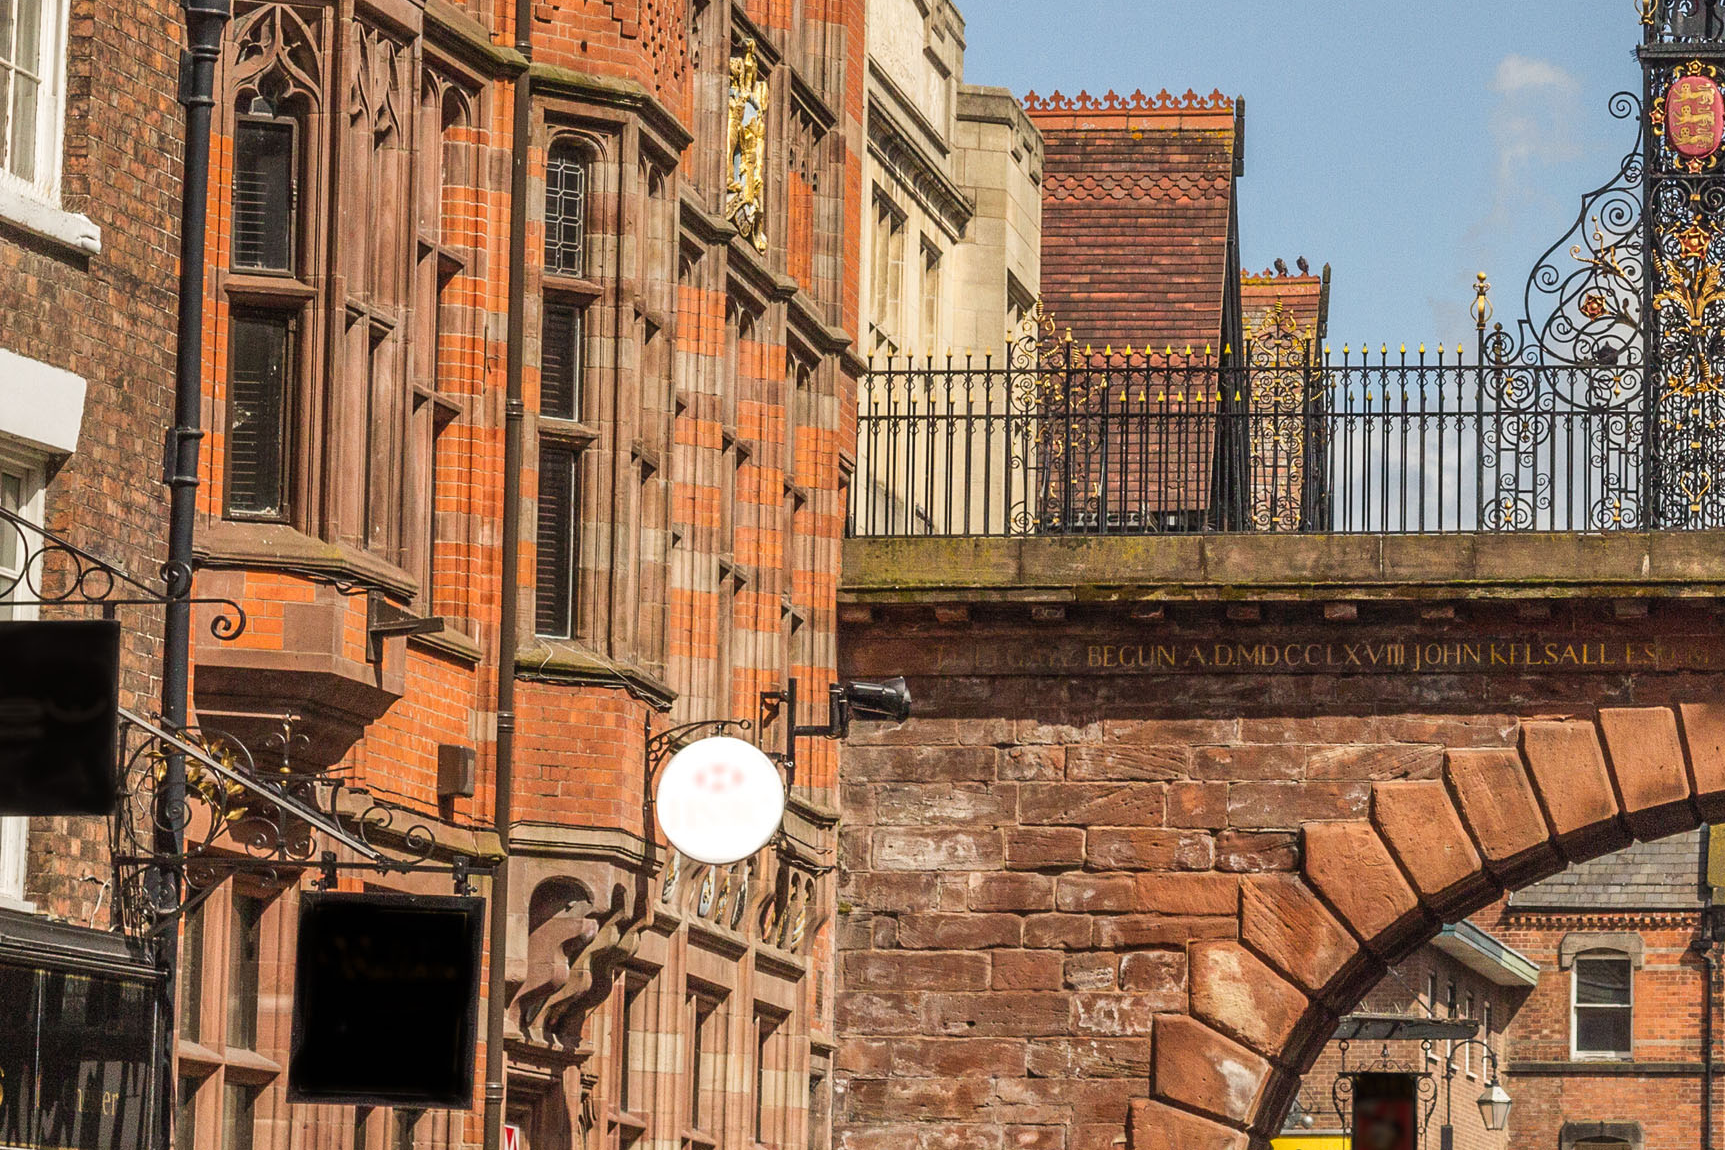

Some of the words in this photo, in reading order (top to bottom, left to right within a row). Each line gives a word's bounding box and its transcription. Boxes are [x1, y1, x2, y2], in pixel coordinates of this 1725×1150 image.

[1087, 644, 1176, 667] BEGUN
[1412, 643, 1481, 671] JOHN
[1490, 643, 1617, 665] KELSALL
